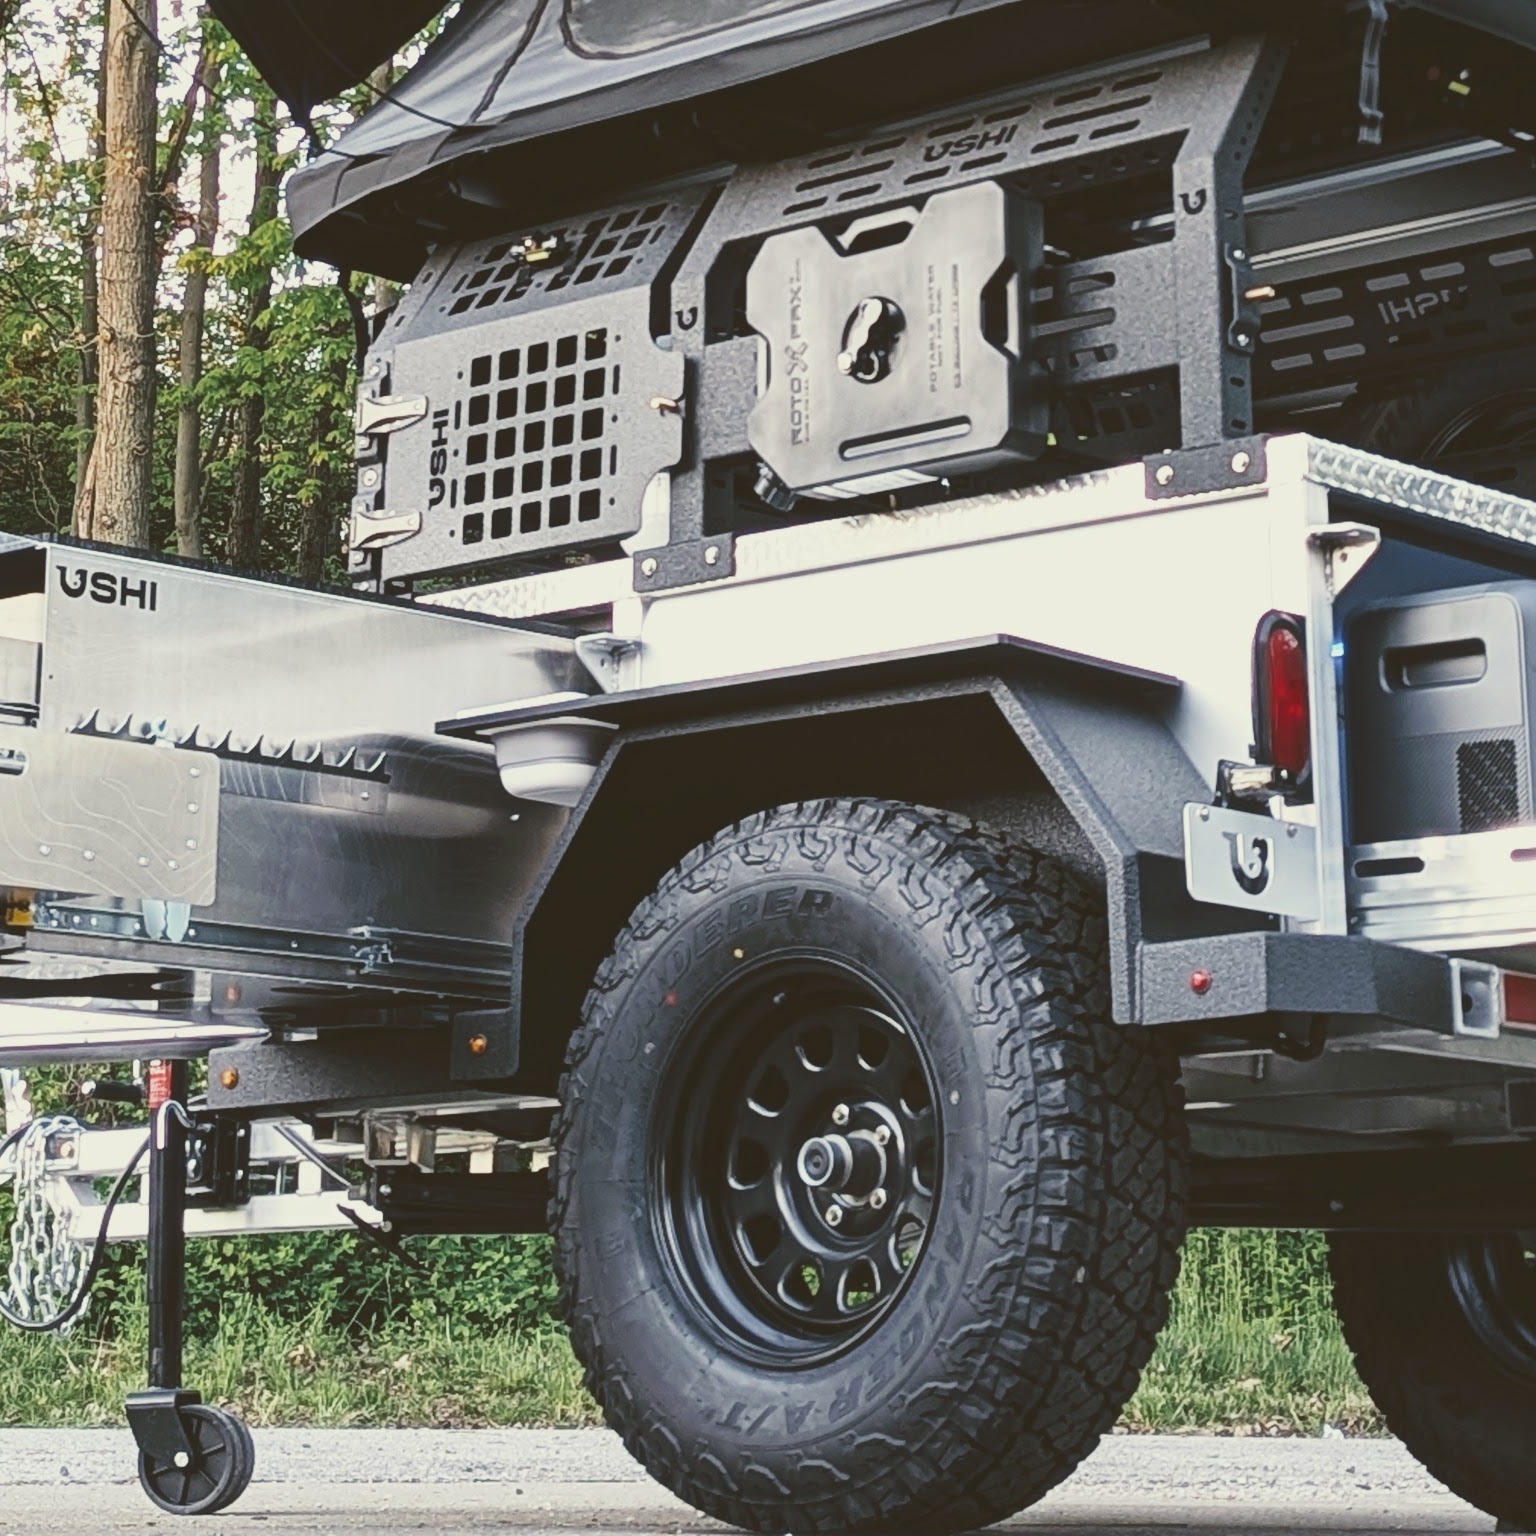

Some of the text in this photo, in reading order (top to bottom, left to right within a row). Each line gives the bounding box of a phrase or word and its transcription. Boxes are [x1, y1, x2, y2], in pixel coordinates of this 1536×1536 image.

[924, 124, 1018, 162] USHI
[427, 408, 449, 512] USHI
[56, 565, 158, 612] USHI
